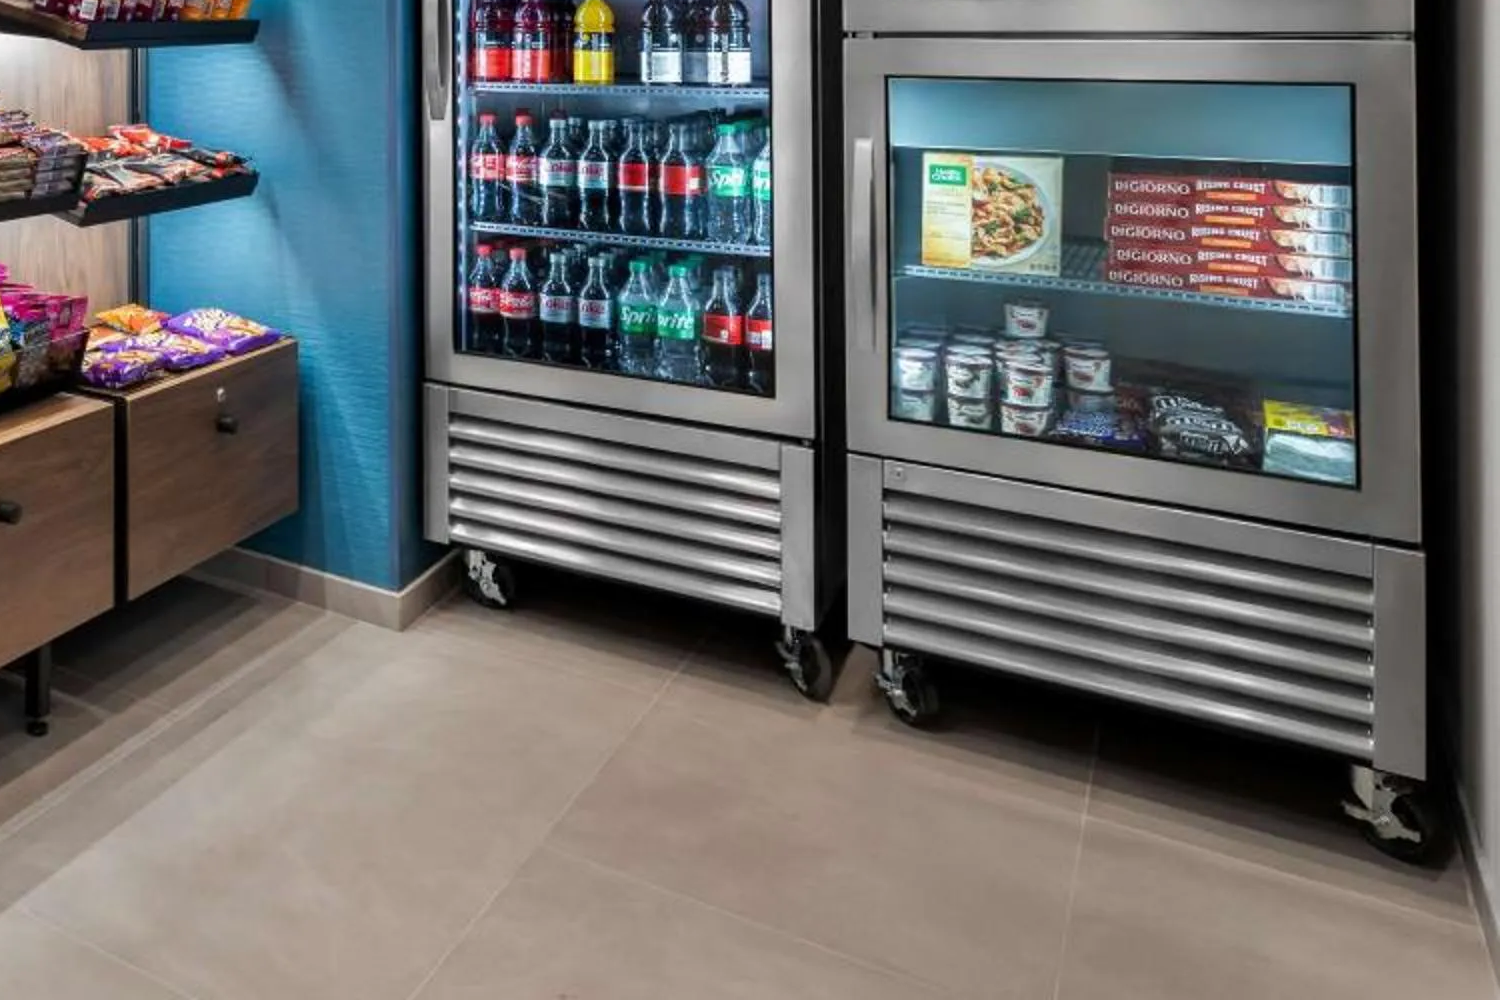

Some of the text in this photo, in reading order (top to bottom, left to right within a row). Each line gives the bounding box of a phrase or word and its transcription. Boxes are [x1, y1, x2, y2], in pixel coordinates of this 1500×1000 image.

[1115, 179, 1190, 195] DIGIORNO
[1115, 203, 1190, 218] DIGIORNO
[1110, 226, 1186, 241] DIGIORNO
[1116, 249, 1193, 265] DIGIORNO
[1108, 271, 1184, 287] DIGIORNO
